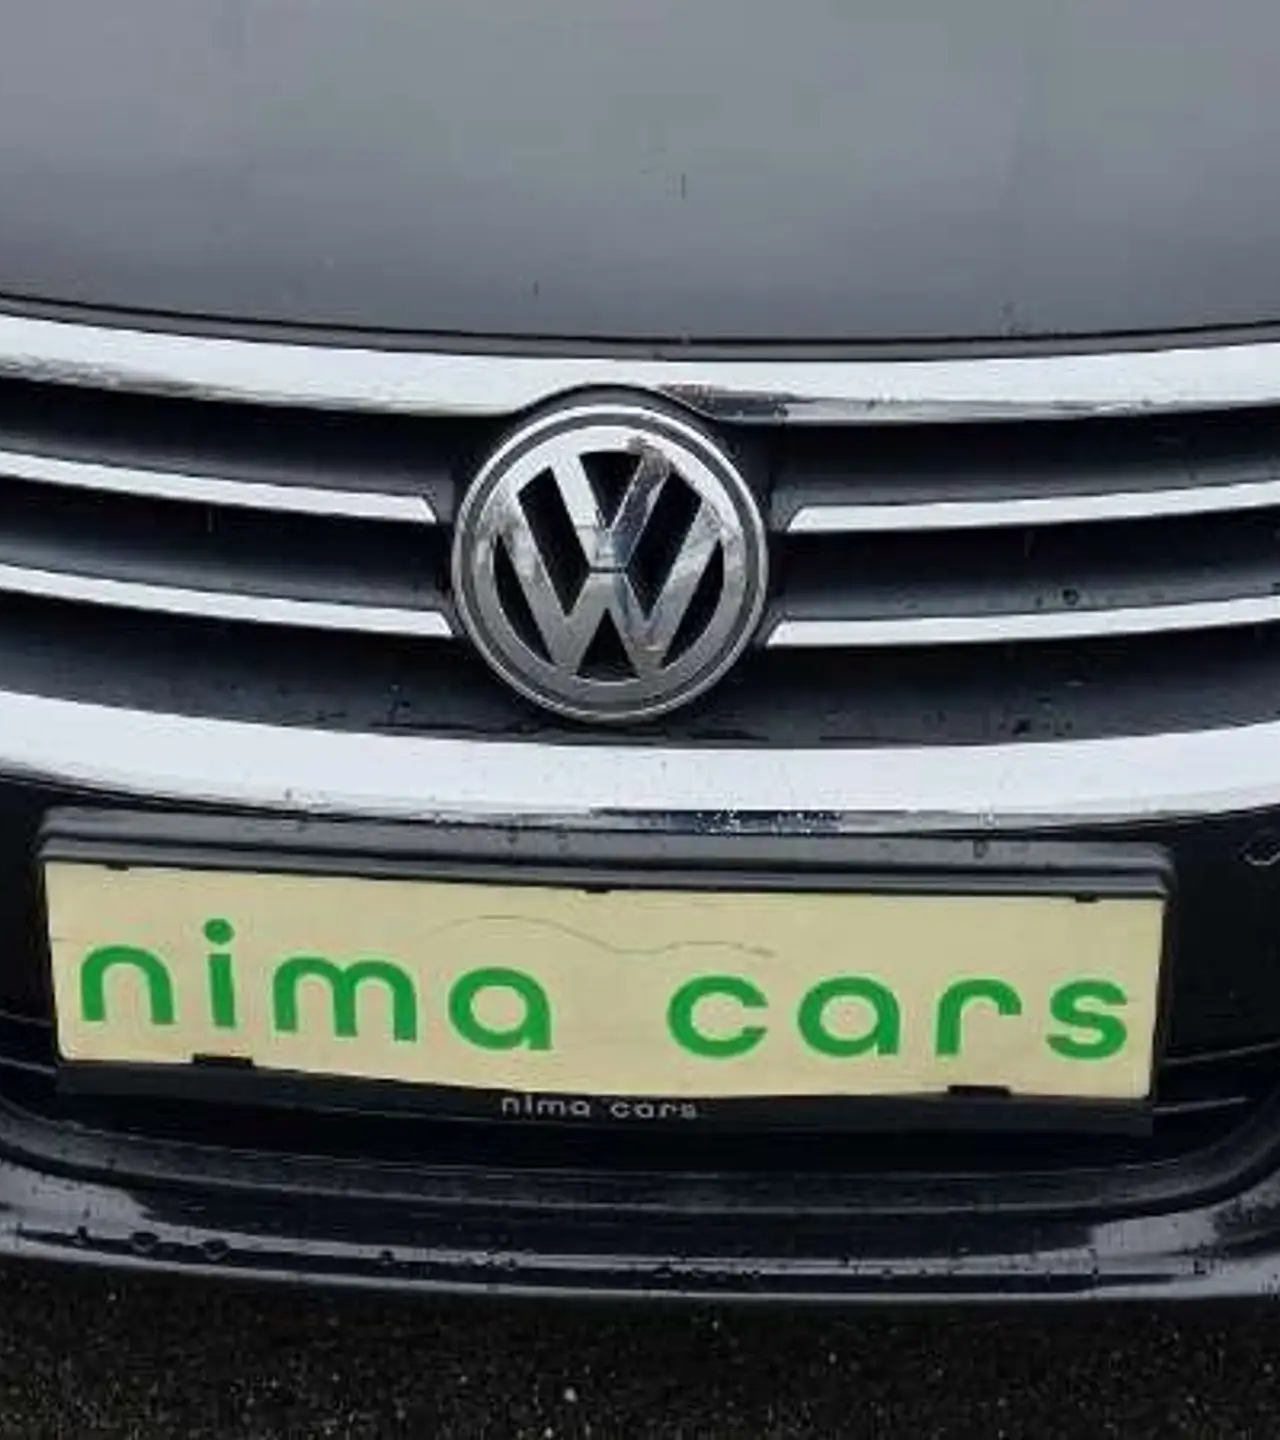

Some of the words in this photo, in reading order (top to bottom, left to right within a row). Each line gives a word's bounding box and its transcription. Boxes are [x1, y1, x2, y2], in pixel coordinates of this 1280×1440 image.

[79, 917, 555, 1053] nima
[665, 972, 1128, 1062] cars
[500, 1094, 592, 1118] nima
[610, 1101, 700, 1119] cars
